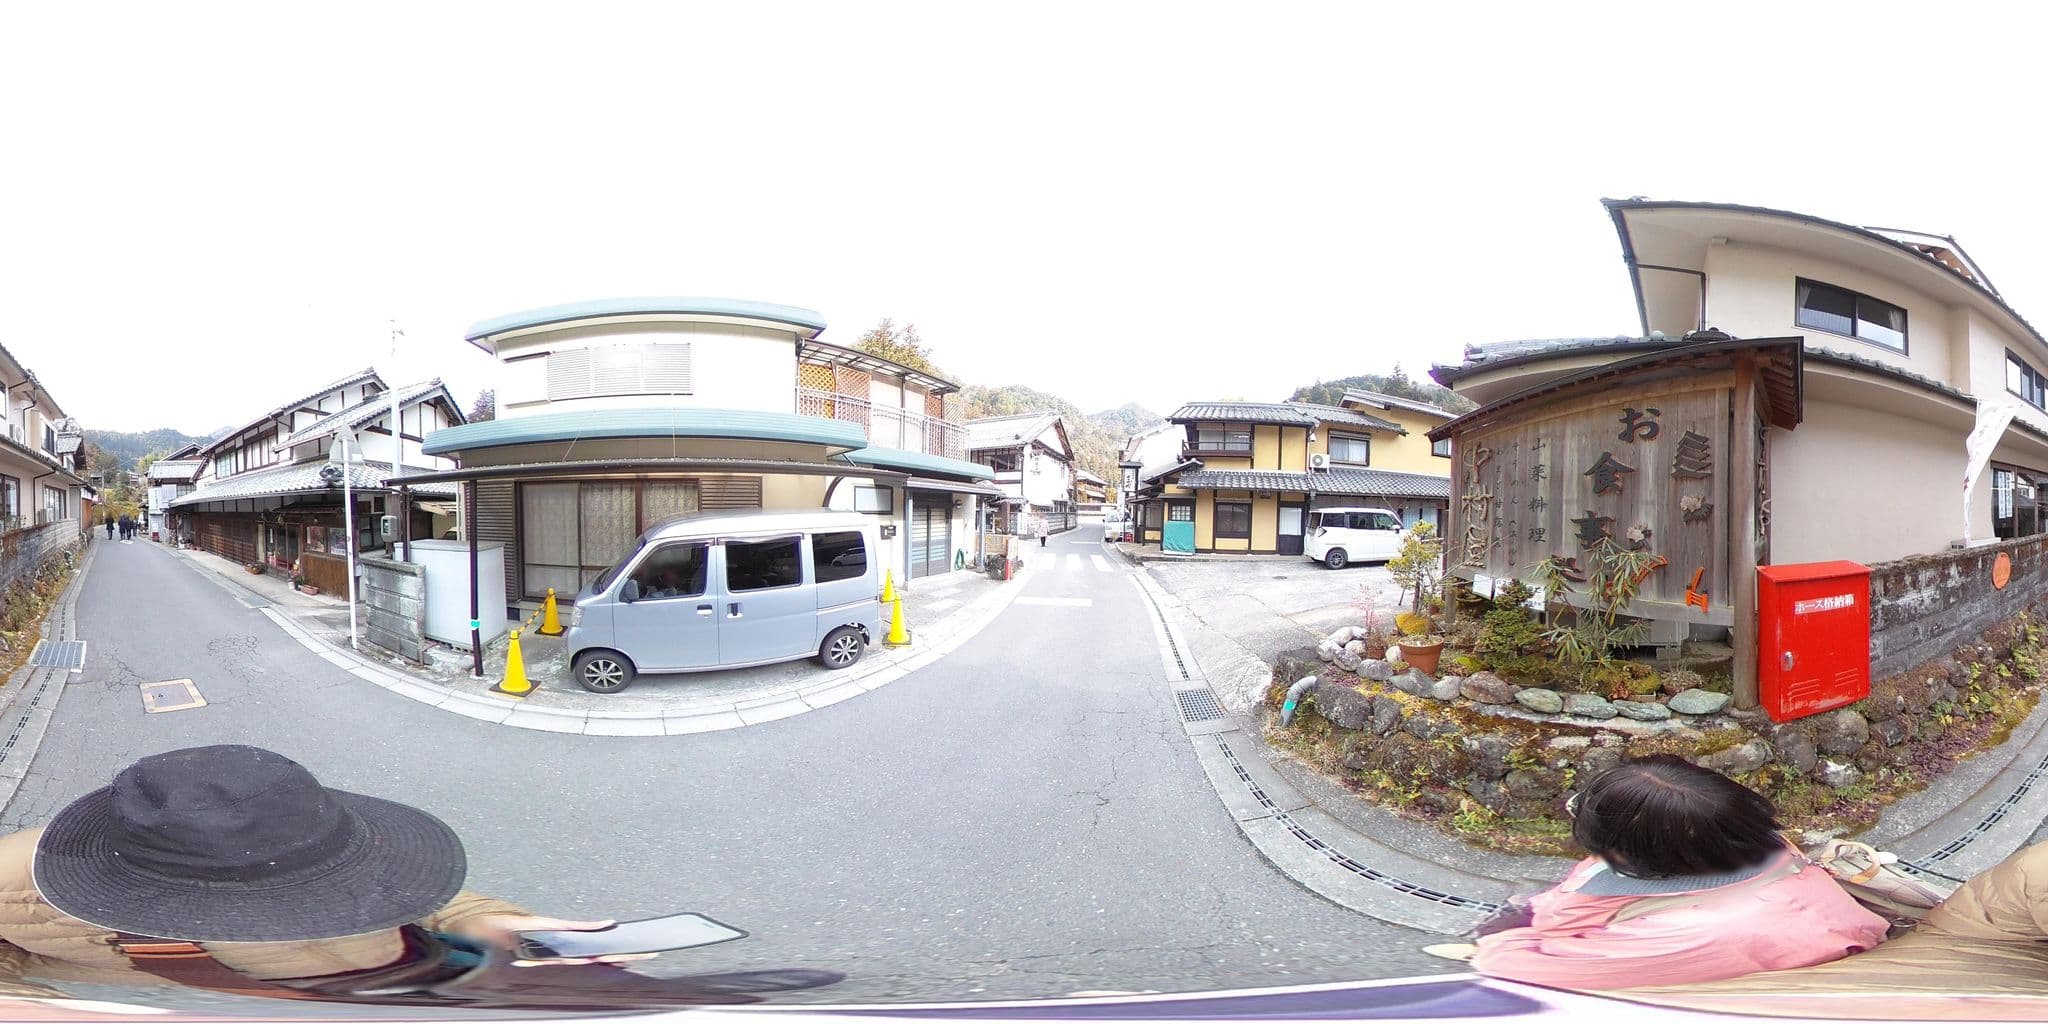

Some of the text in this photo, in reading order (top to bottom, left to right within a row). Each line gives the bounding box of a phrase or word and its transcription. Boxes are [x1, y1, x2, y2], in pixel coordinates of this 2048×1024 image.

[1462, 441, 1494, 568] 中村屋
[1528, 438, 1548, 543] 山菜料理
[1795, 594, 1854, 613] ホース格納箱
